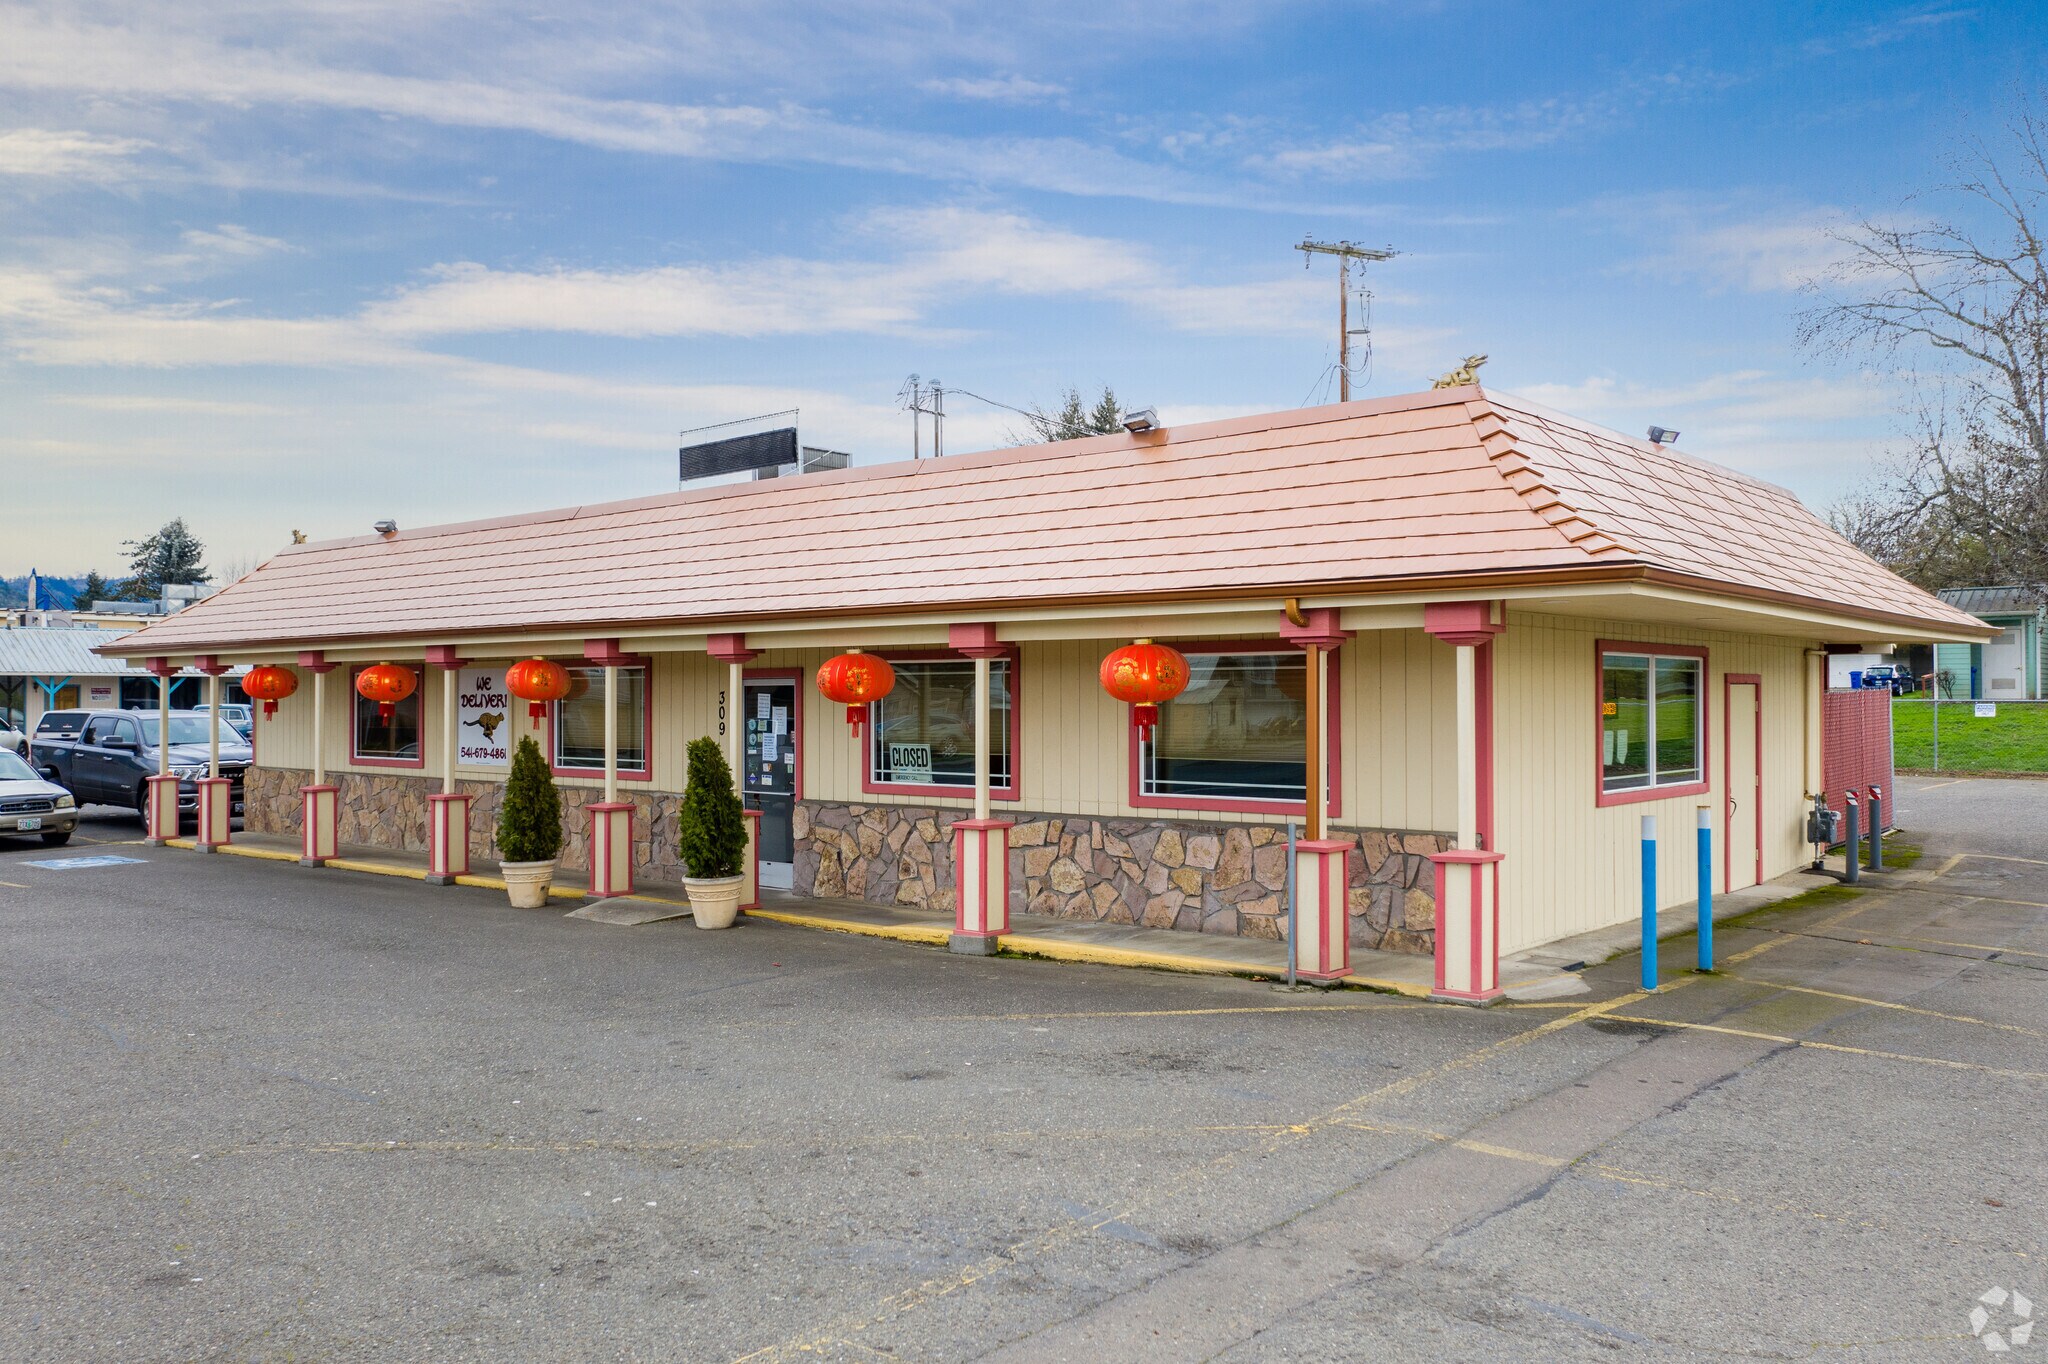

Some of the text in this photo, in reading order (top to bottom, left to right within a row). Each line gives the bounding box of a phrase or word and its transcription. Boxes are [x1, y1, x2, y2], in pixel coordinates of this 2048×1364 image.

[476, 676, 492, 691] WE
[461, 693, 508, 708] DELIVER!
[461, 746, 507, 759] 541-679-4861
[892, 747, 929, 767] CLOSED
